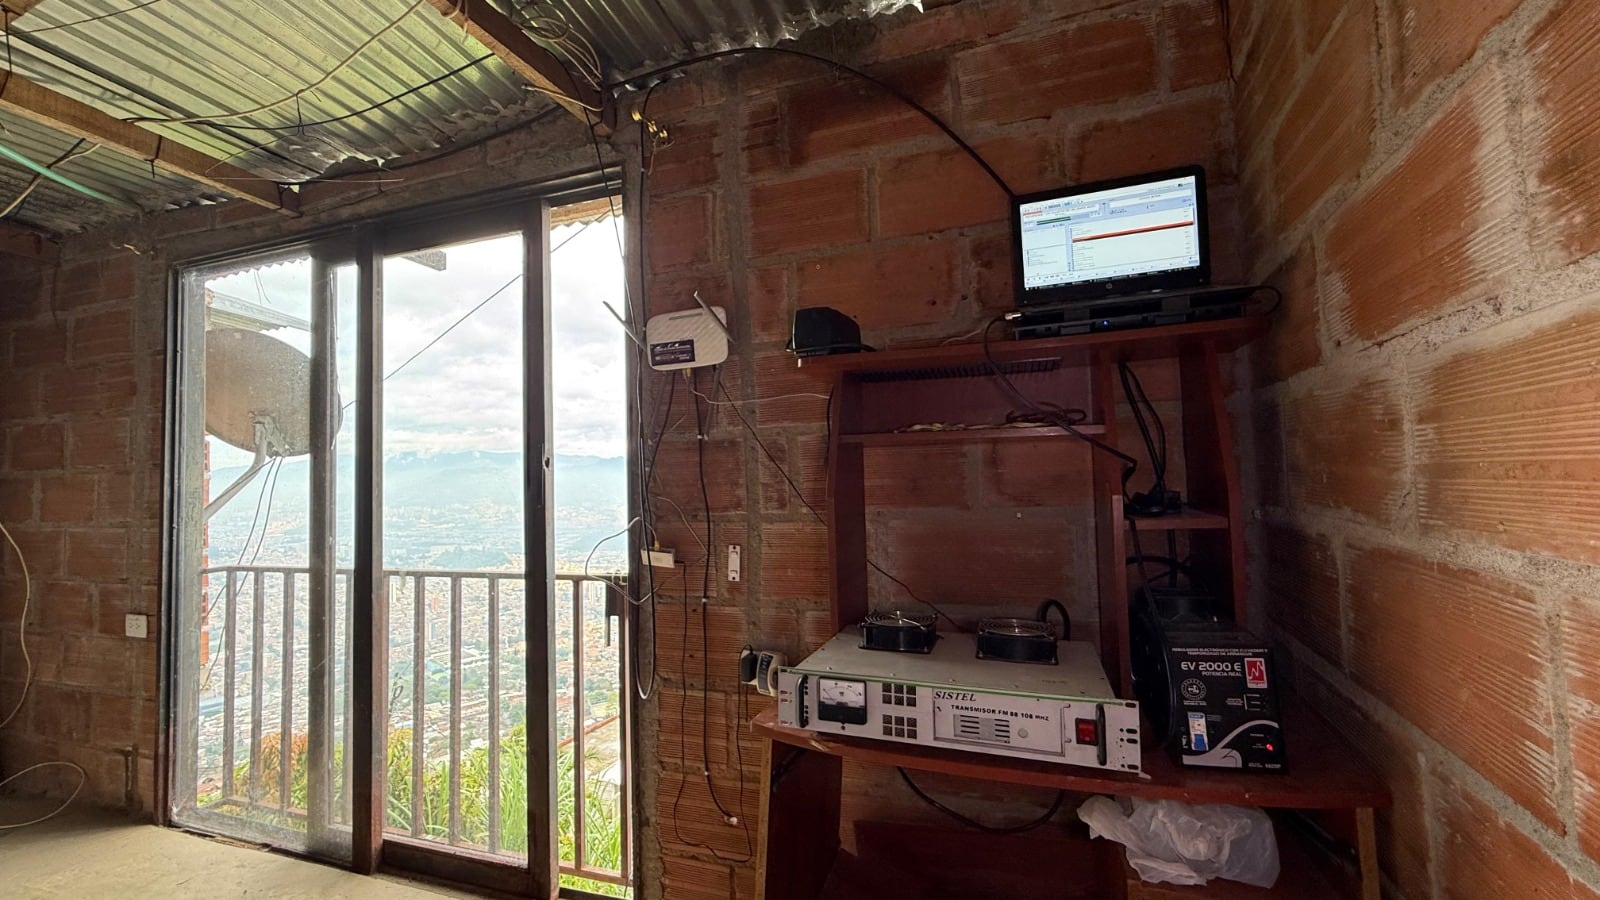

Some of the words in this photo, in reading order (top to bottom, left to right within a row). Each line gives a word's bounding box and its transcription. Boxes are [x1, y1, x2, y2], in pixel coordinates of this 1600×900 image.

[1180, 662, 1196, 671] EV
[1198, 662, 1232, 672] 2000
[1234, 662, 1242, 672] E
[934, 690, 977, 702] SISTEL
[951, 704, 996, 715] TRANSMISOR
